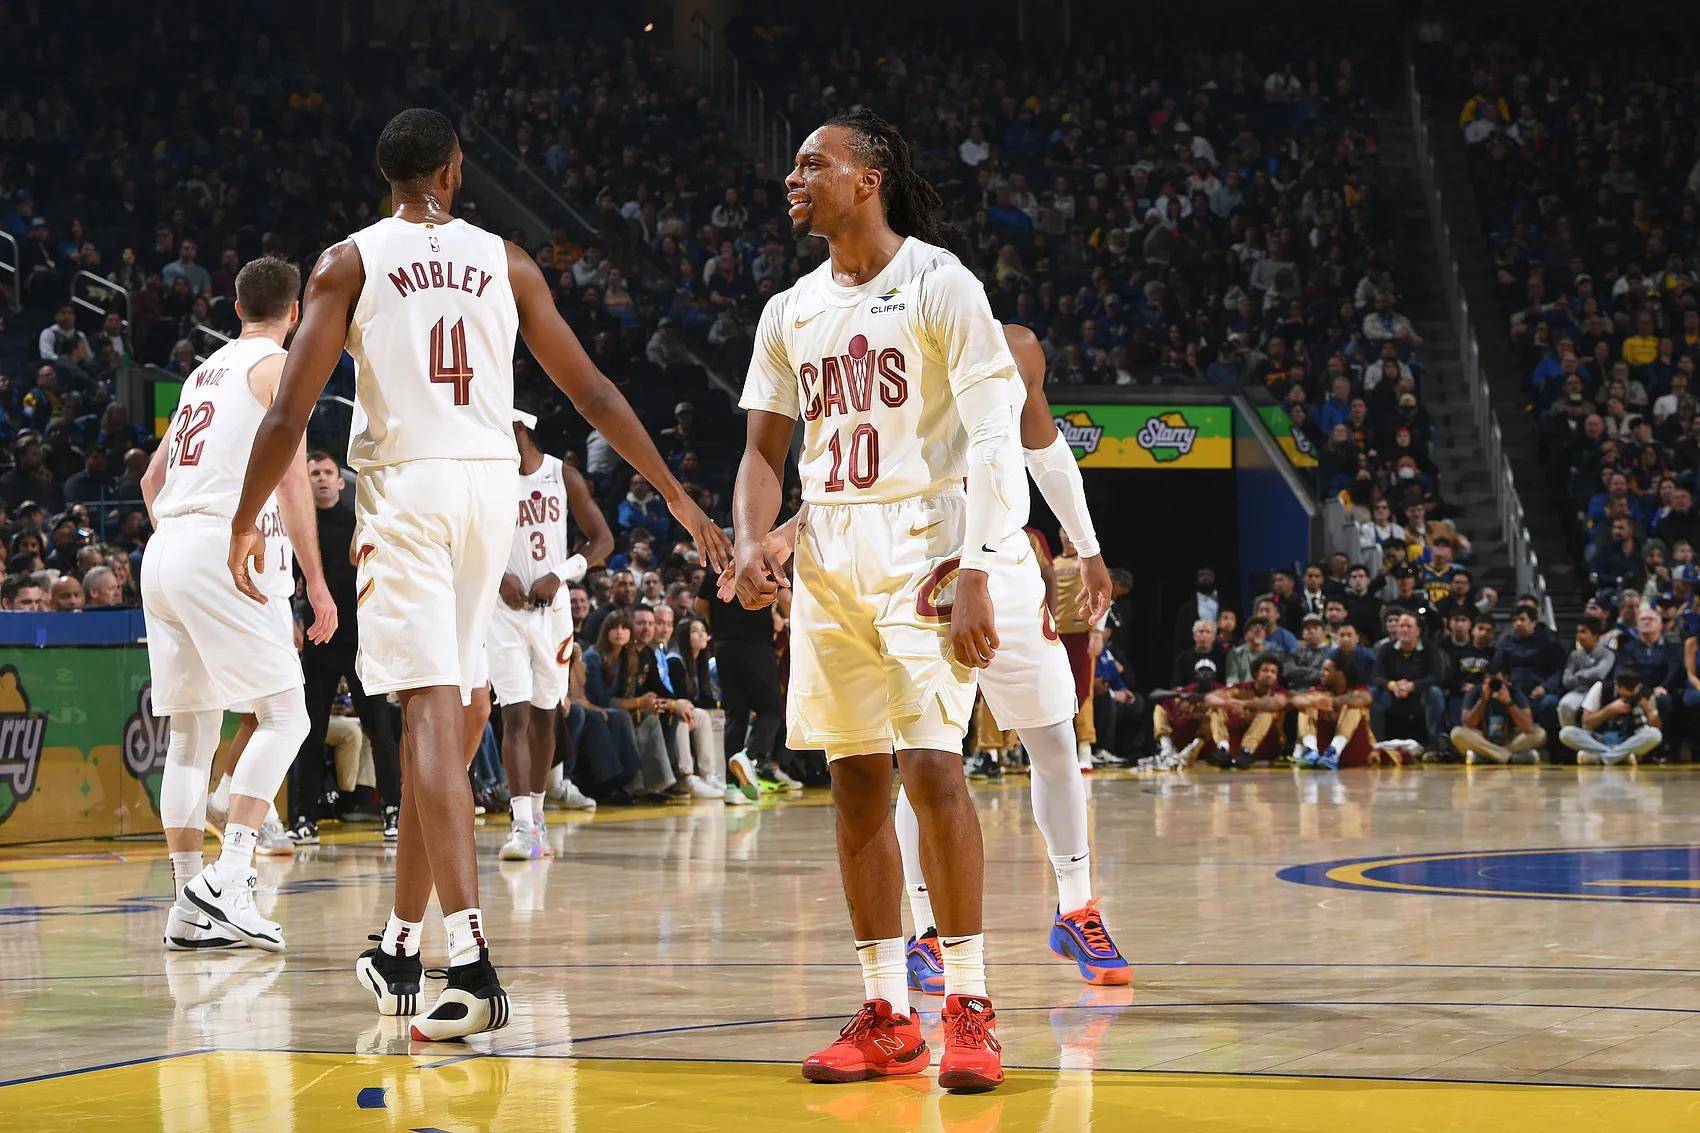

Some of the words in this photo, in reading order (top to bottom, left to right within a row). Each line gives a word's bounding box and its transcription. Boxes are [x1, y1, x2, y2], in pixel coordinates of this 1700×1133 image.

[388, 261, 492, 298] MOBLEY
[870, 303, 905, 314] CLIFFS
[195, 367, 229, 389] WADE
[429, 316, 474, 406] 4
[800, 347, 908, 421] CAVS
[170, 401, 215, 469] 32
[1138, 418, 1196, 454] Starry
[824, 423, 880, 493] 10
[518, 496, 560, 528] AVS
[529, 531, 546, 561] 3
[0, 718, 43, 795] rry
